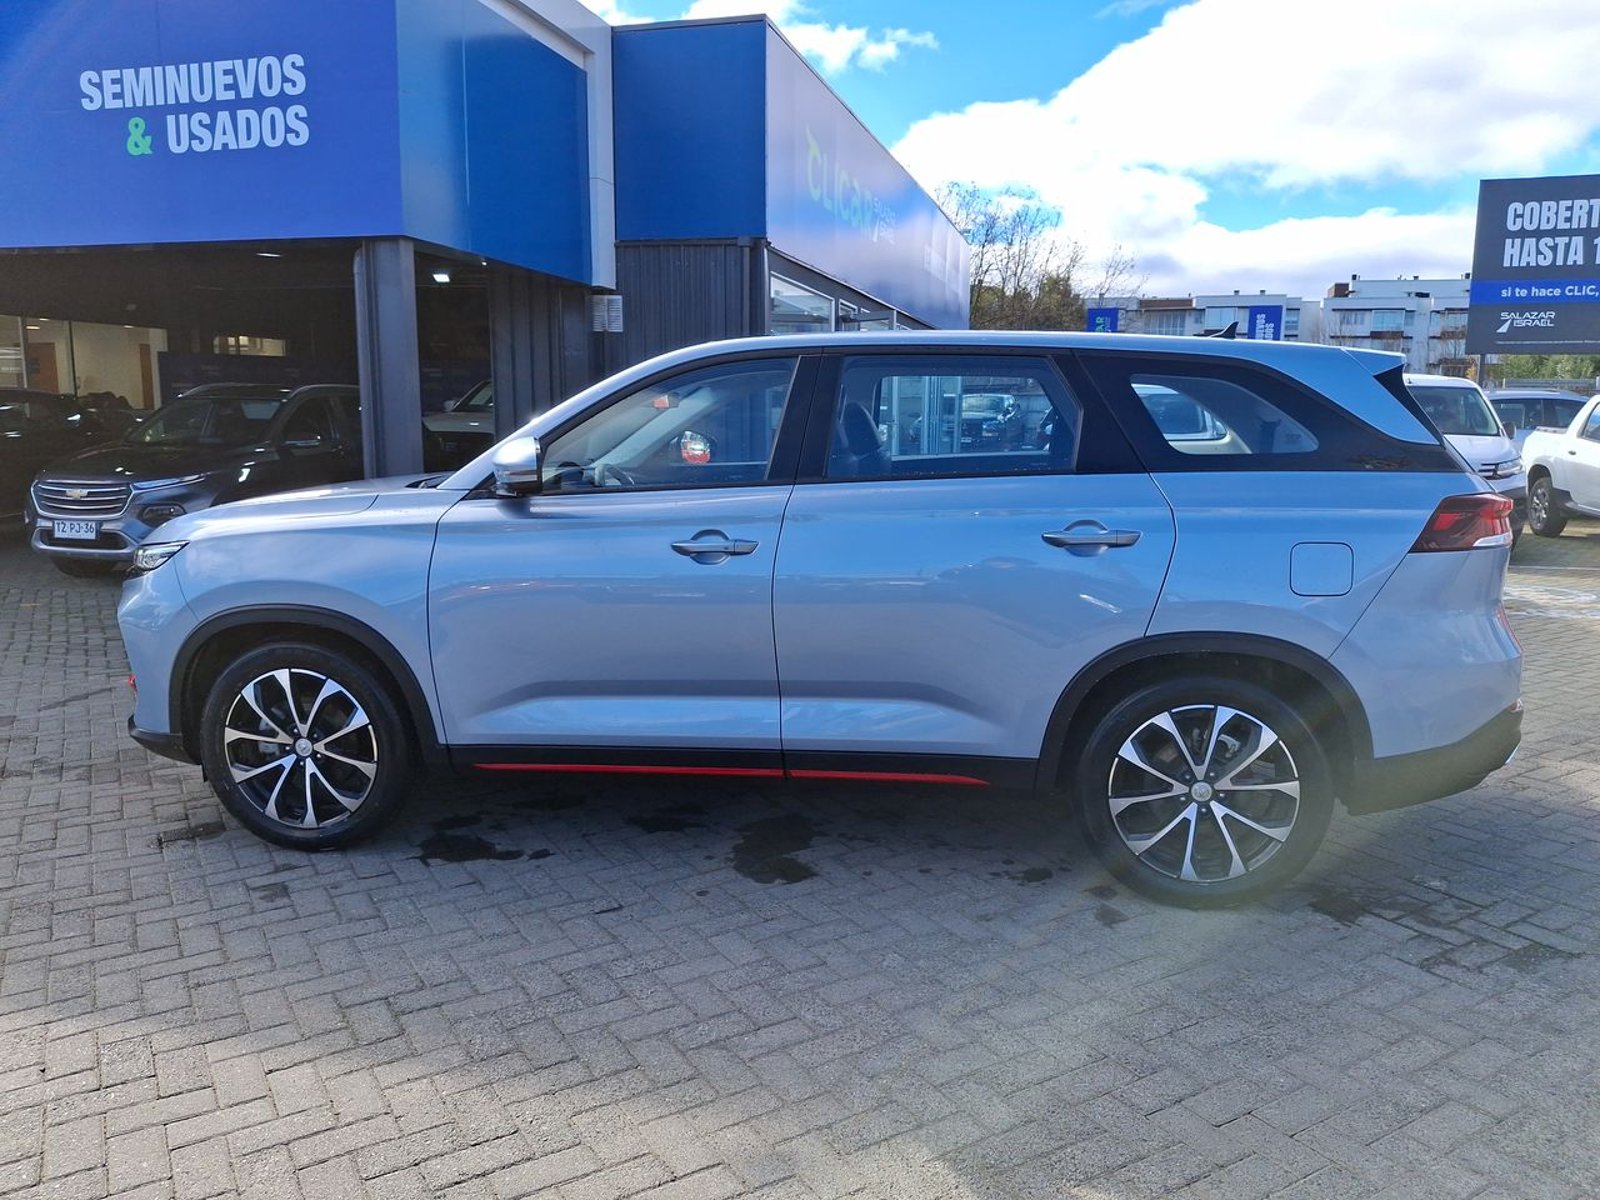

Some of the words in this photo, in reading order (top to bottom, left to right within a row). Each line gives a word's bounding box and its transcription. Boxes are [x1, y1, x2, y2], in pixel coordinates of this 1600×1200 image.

[79, 53, 307, 111] SEMINUEVOS
[126, 116, 153, 156] &
[166, 104, 310, 154] USADOS
[1502, 235, 1584, 268] HASTA
[1501, 286, 1512, 297] si
[1515, 287, 1528, 297] te
[1531, 285, 1561, 297] hace
[1565, 284, 1600, 297] CLIC,
[1500, 311, 1556, 320] SALAZAR
[1513, 319, 1555, 327] ISRAEL
